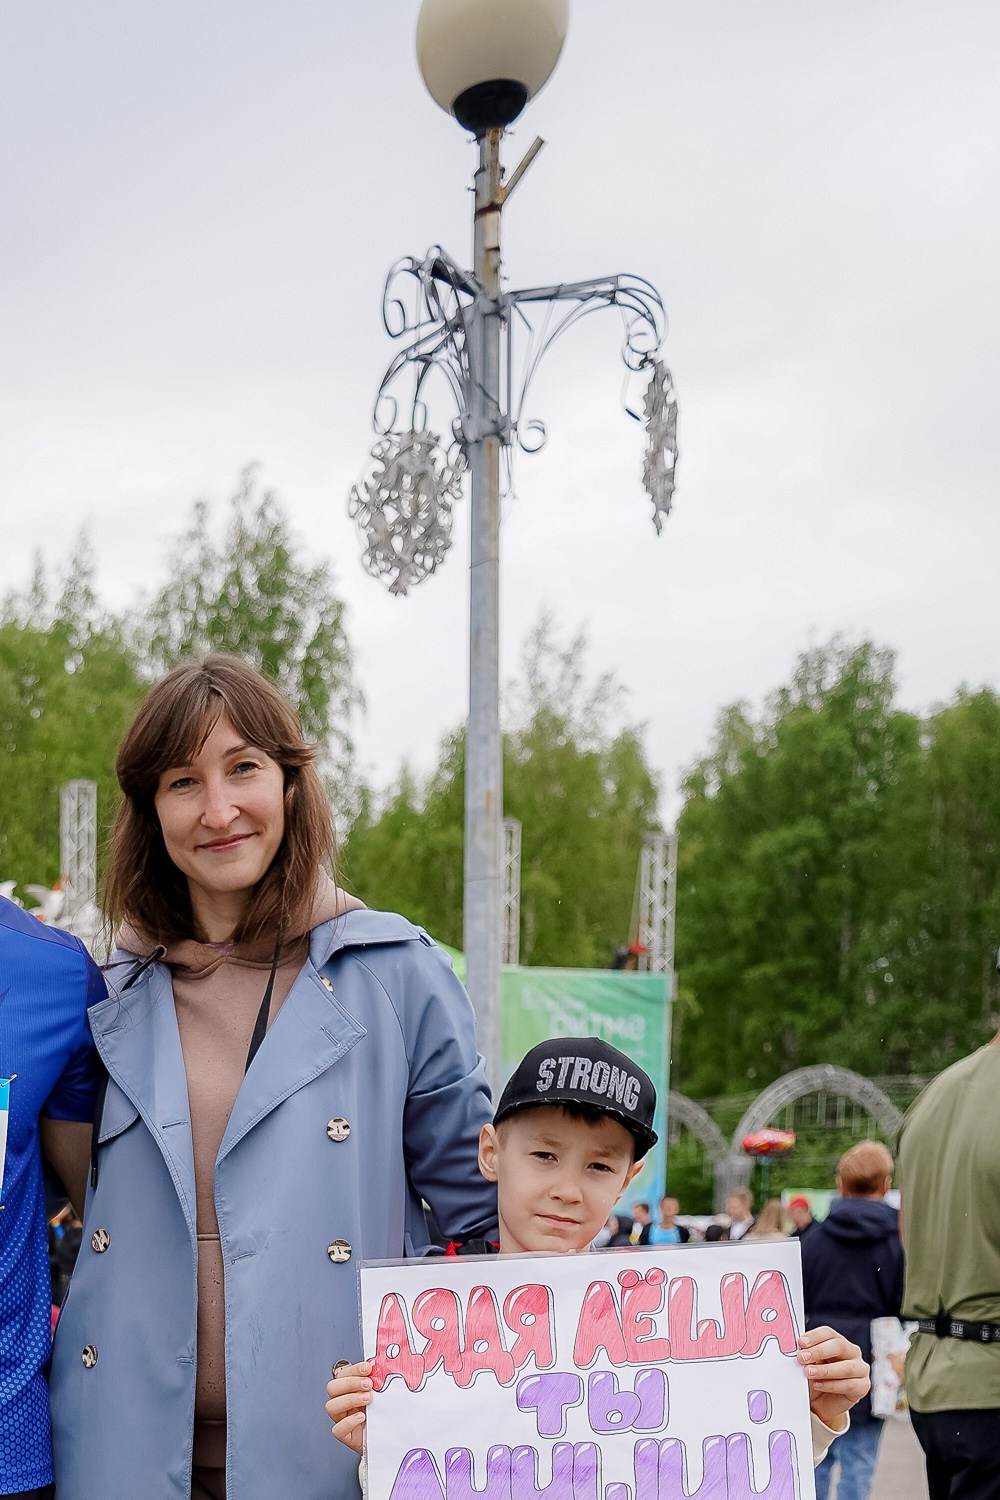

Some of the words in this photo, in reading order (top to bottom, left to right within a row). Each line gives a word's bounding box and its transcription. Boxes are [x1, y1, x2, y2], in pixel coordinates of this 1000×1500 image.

[536, 1056, 642, 1111] STRONG
[367, 1283, 556, 1392] ДЯДЯ
[573, 1267, 799, 1368] ЛЁША
[516, 1368, 669, 1439] ТЫ
